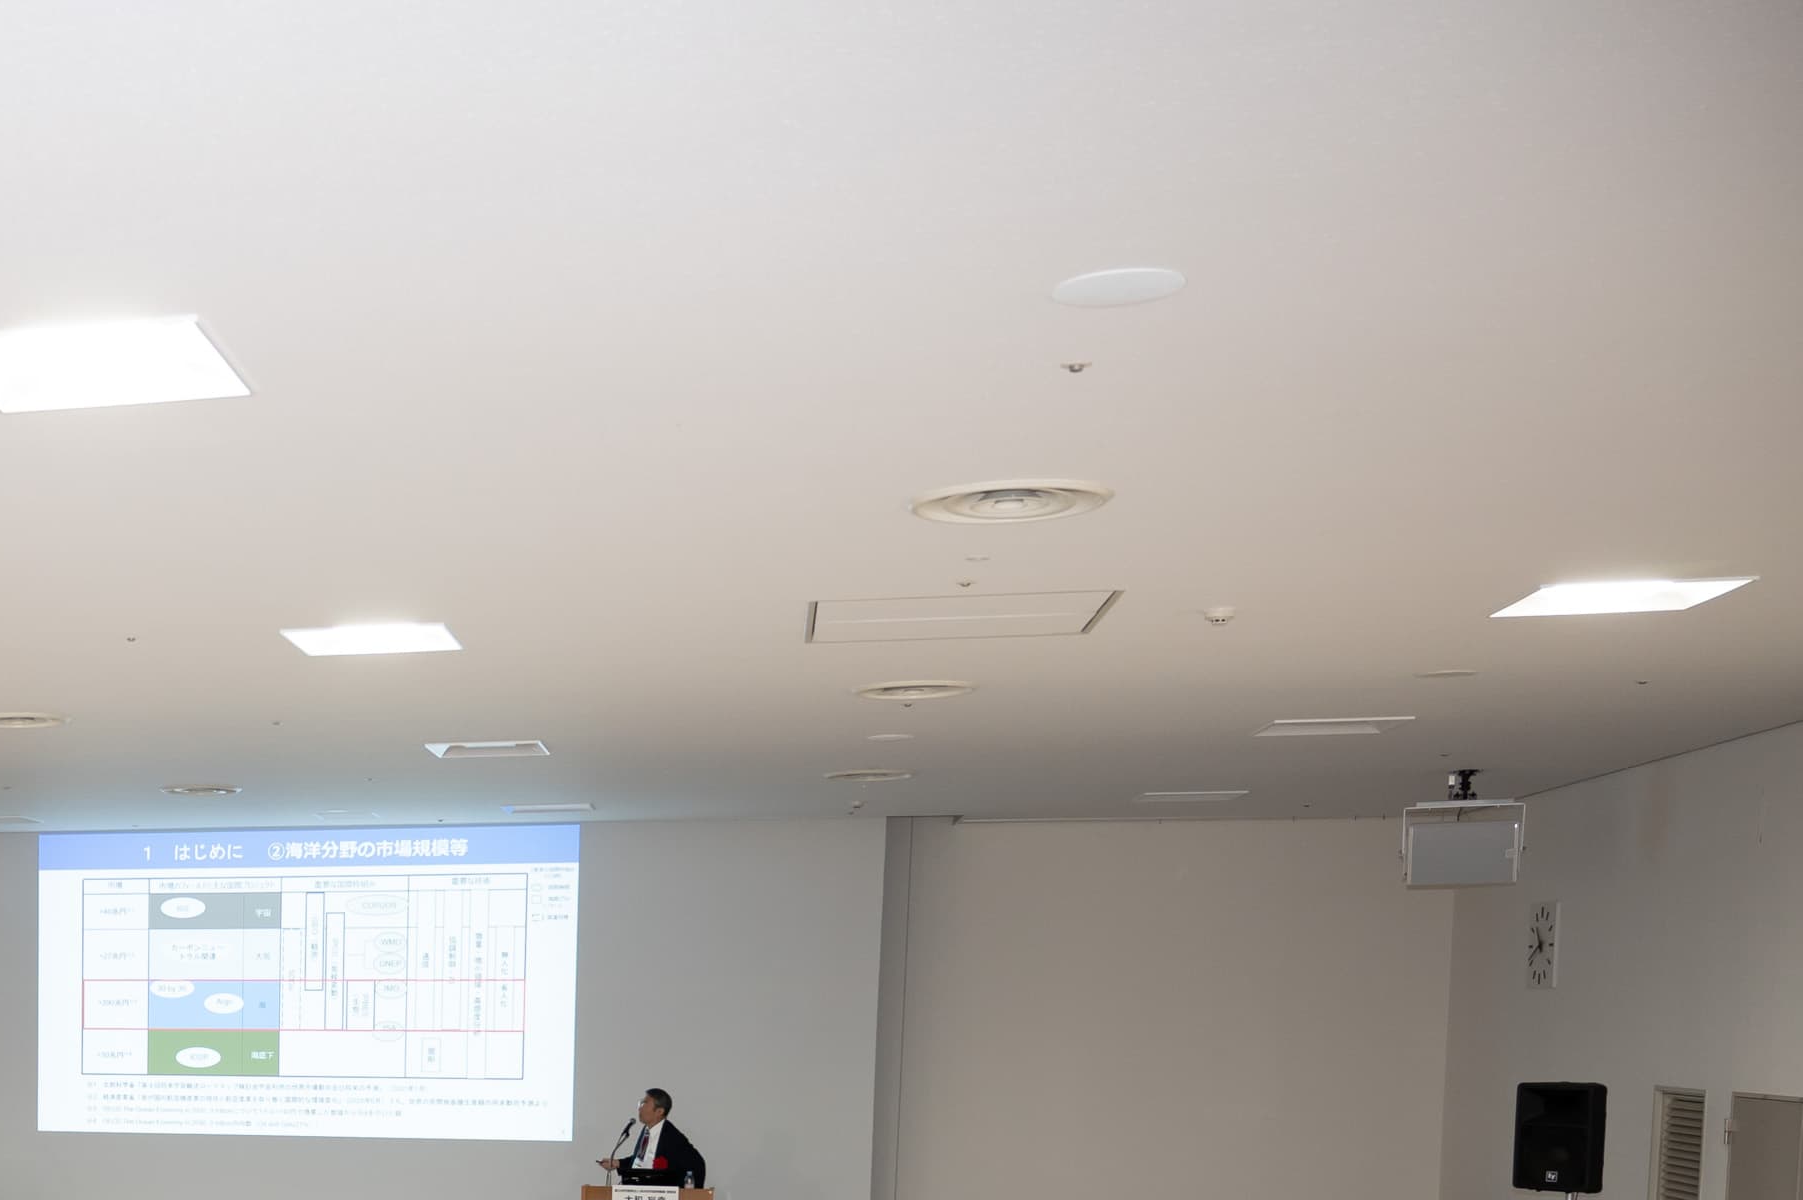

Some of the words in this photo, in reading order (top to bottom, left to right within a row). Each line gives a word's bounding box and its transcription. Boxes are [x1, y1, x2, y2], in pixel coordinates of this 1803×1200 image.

[144, 845, 152, 860] 1
[174, 843, 243, 861] はじめに
[267, 838, 469, 860] ②海洋分野の市場規模等
